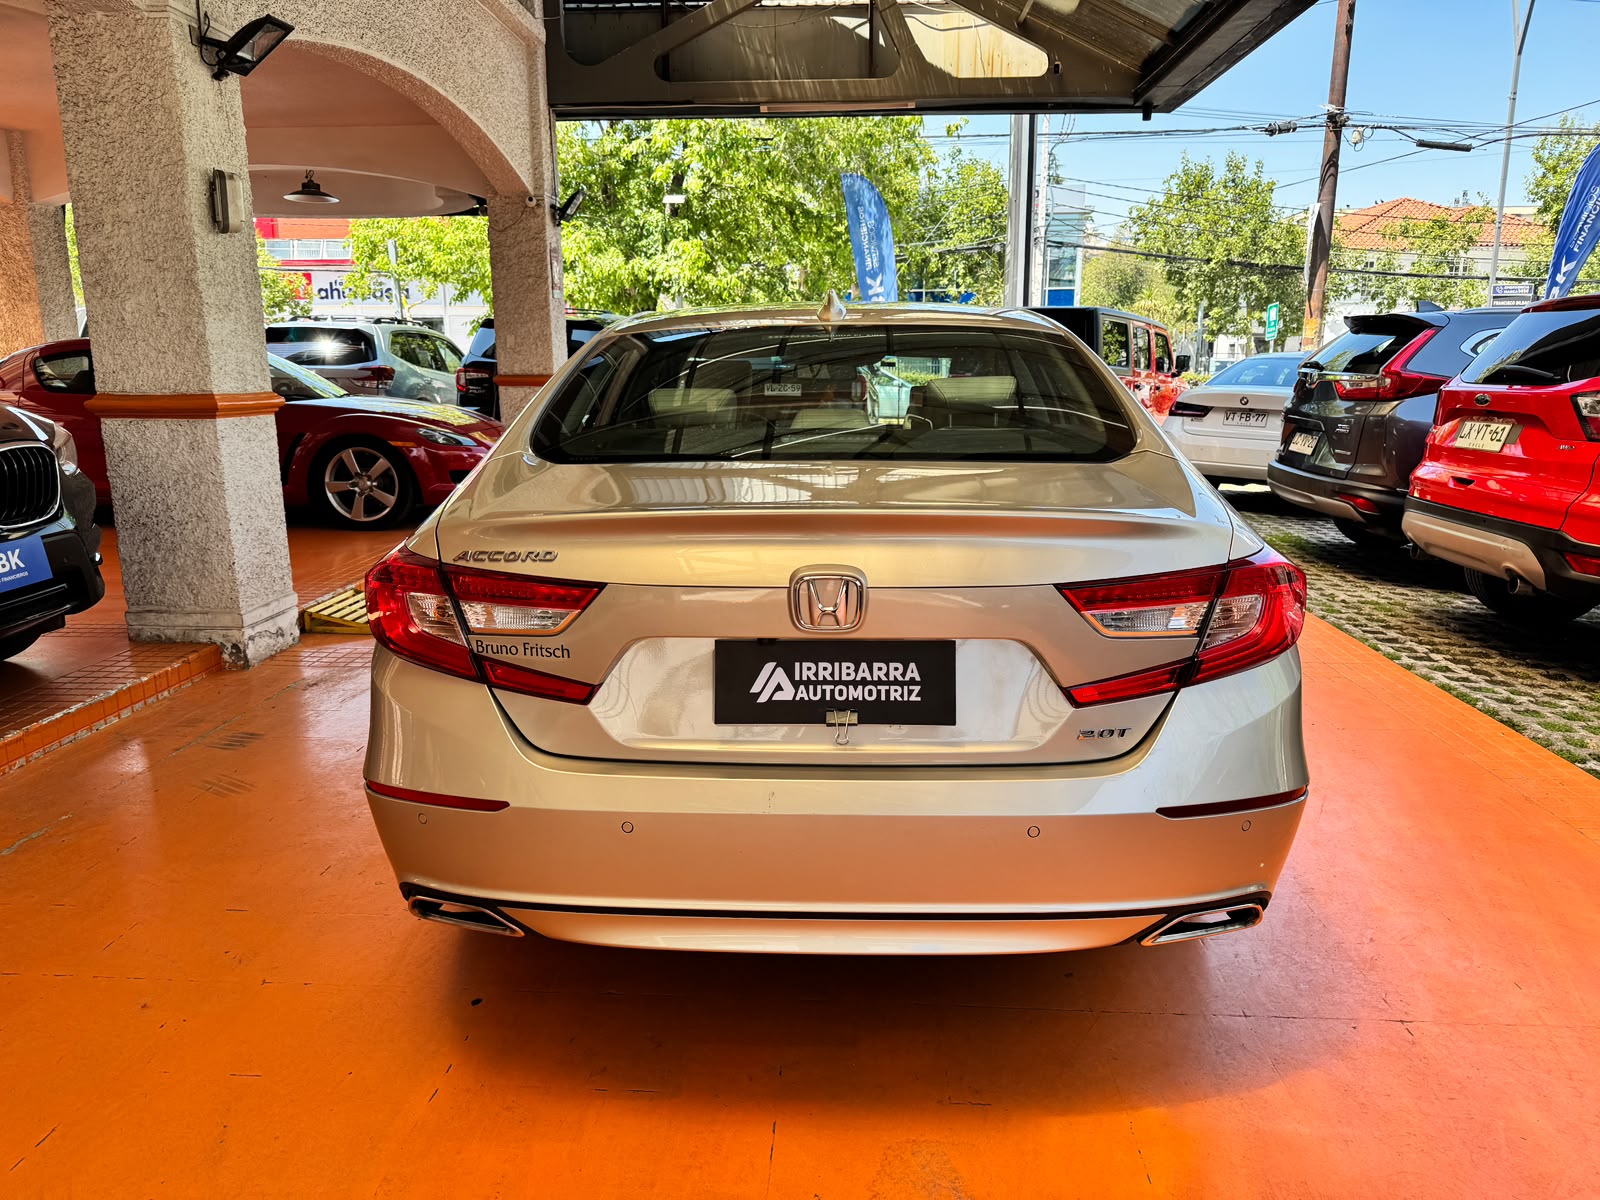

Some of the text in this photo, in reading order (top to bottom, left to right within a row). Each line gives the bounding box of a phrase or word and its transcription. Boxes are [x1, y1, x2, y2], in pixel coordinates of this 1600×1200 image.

[452, 550, 559, 562] ACCORD
[475, 639, 571, 659] Bruno Fritsch
[794, 661, 922, 682] IRRIBARRA
[795, 684, 922, 702] AUTOMOTRIZ
